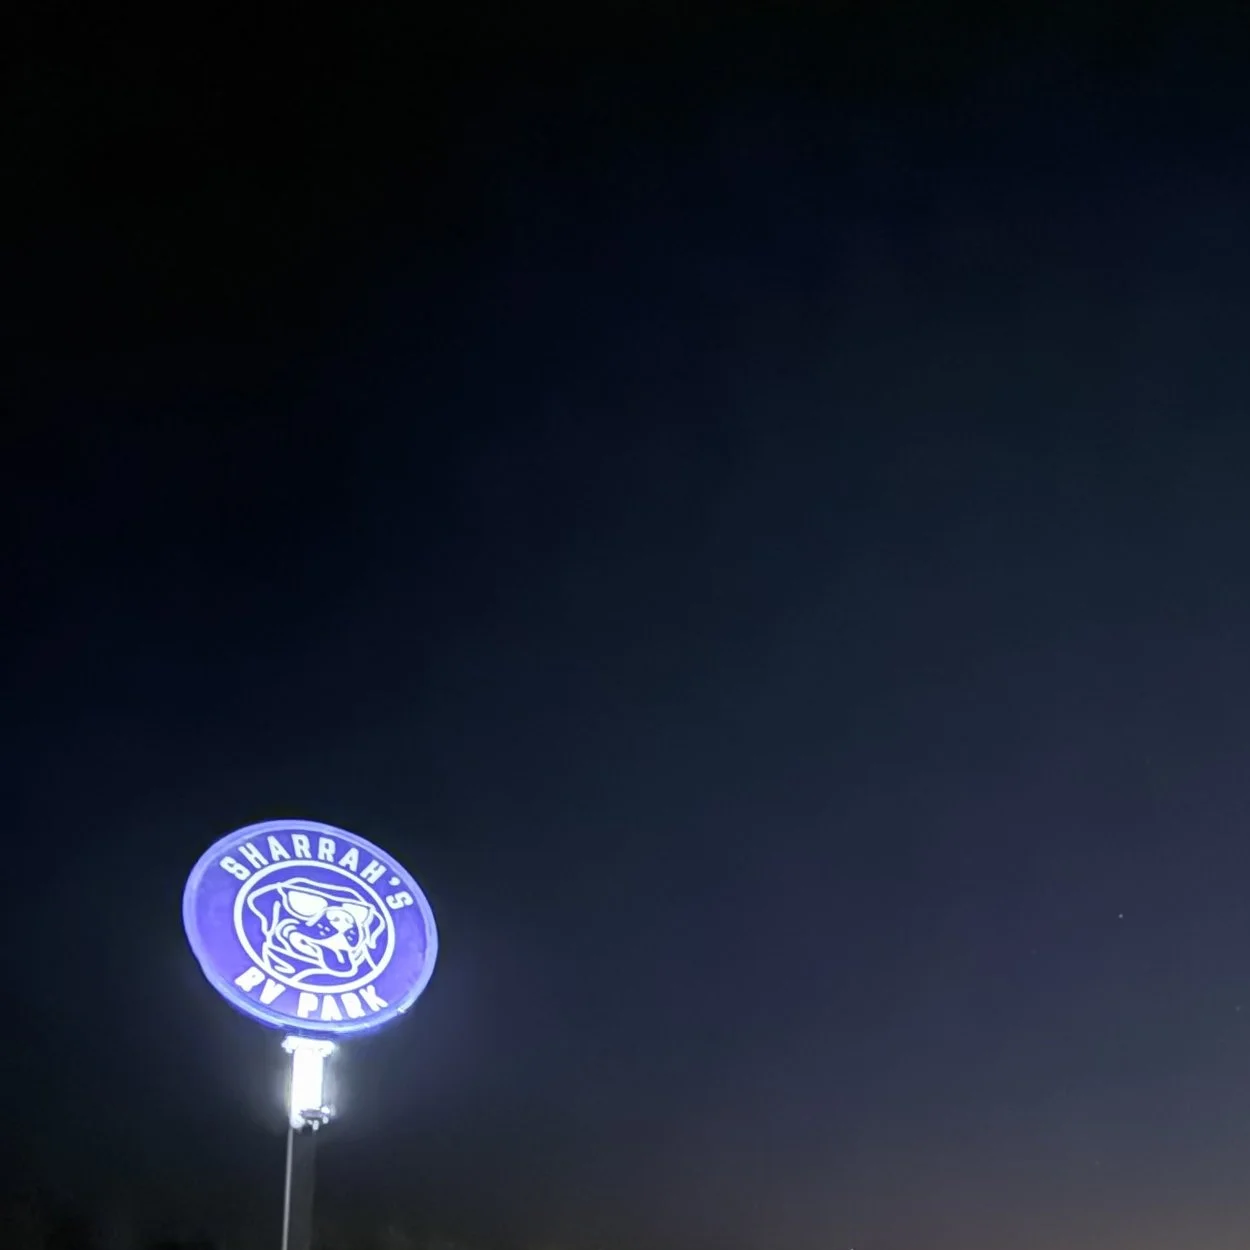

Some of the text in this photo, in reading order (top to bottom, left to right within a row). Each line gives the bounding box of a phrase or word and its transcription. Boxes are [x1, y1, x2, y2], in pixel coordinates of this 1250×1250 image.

[219, 833, 414, 910] SHARRAH'S
[234, 966, 389, 1021] RV PARK
